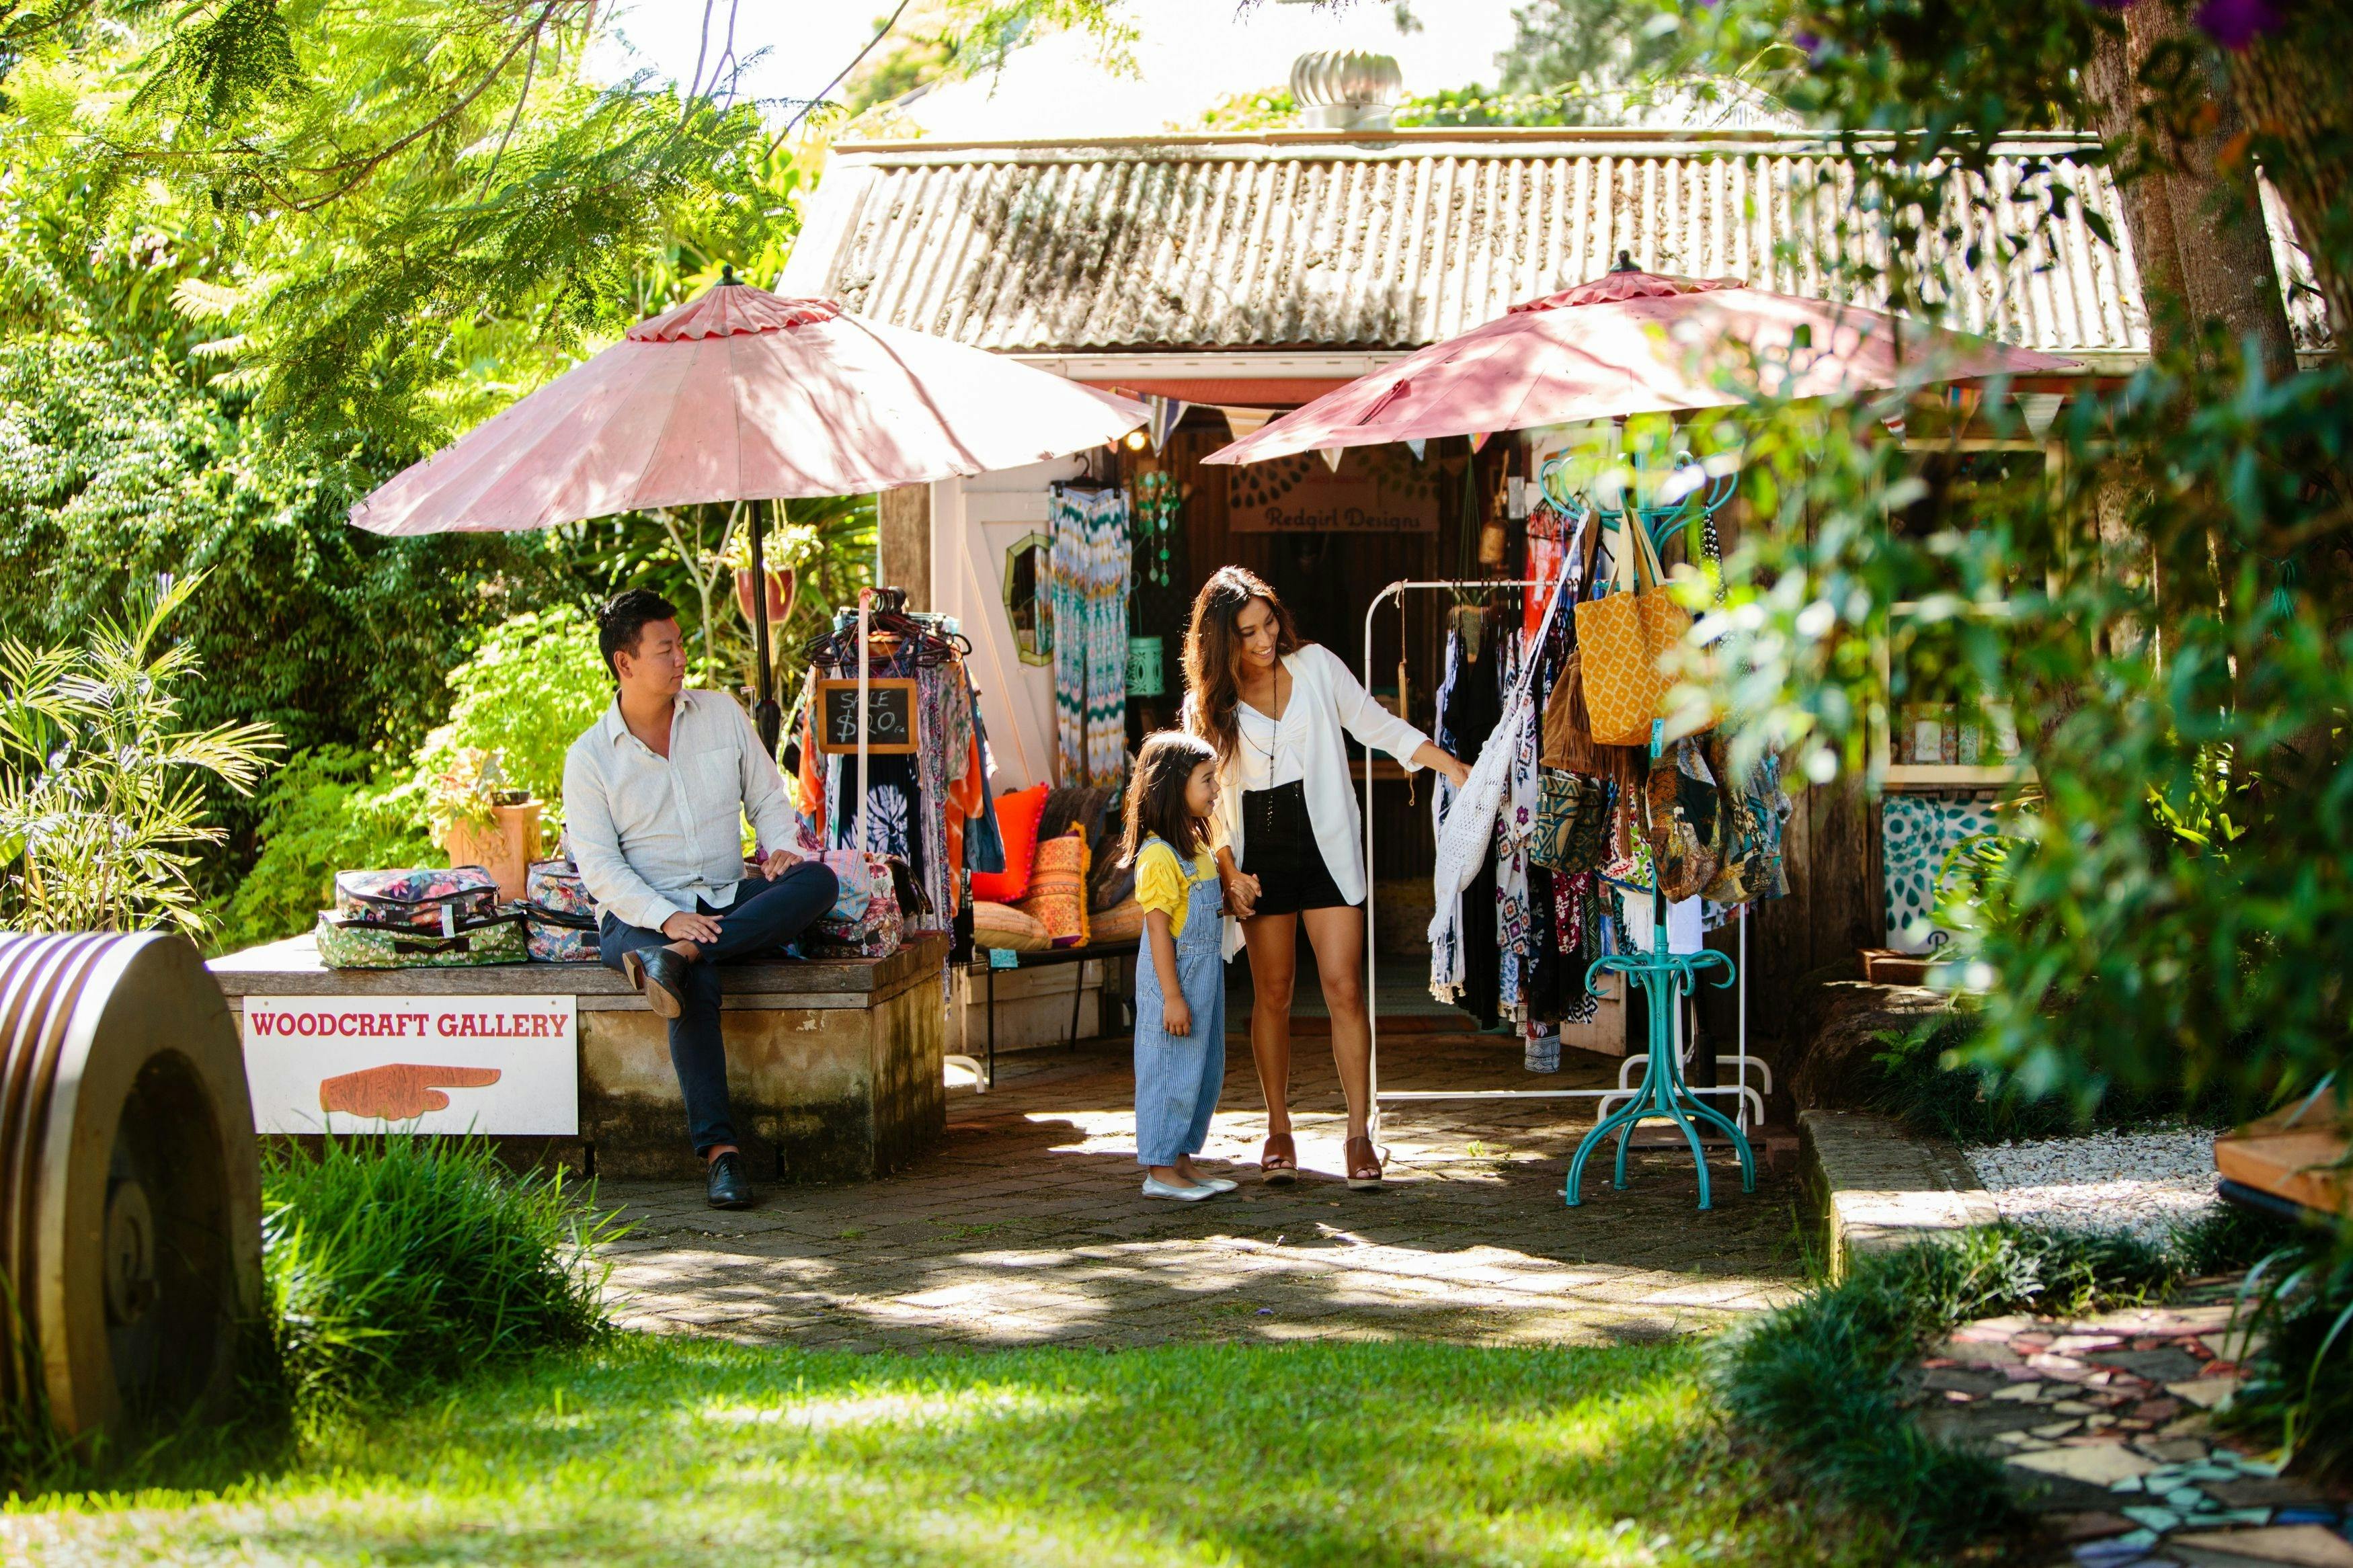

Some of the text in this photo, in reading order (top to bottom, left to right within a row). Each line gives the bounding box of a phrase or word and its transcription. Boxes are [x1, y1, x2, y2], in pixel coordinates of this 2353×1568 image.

[1265, 507, 1421, 530] Redgirl Designs
[251, 1013, 569, 1037] WOODCRAFT GALLERY
